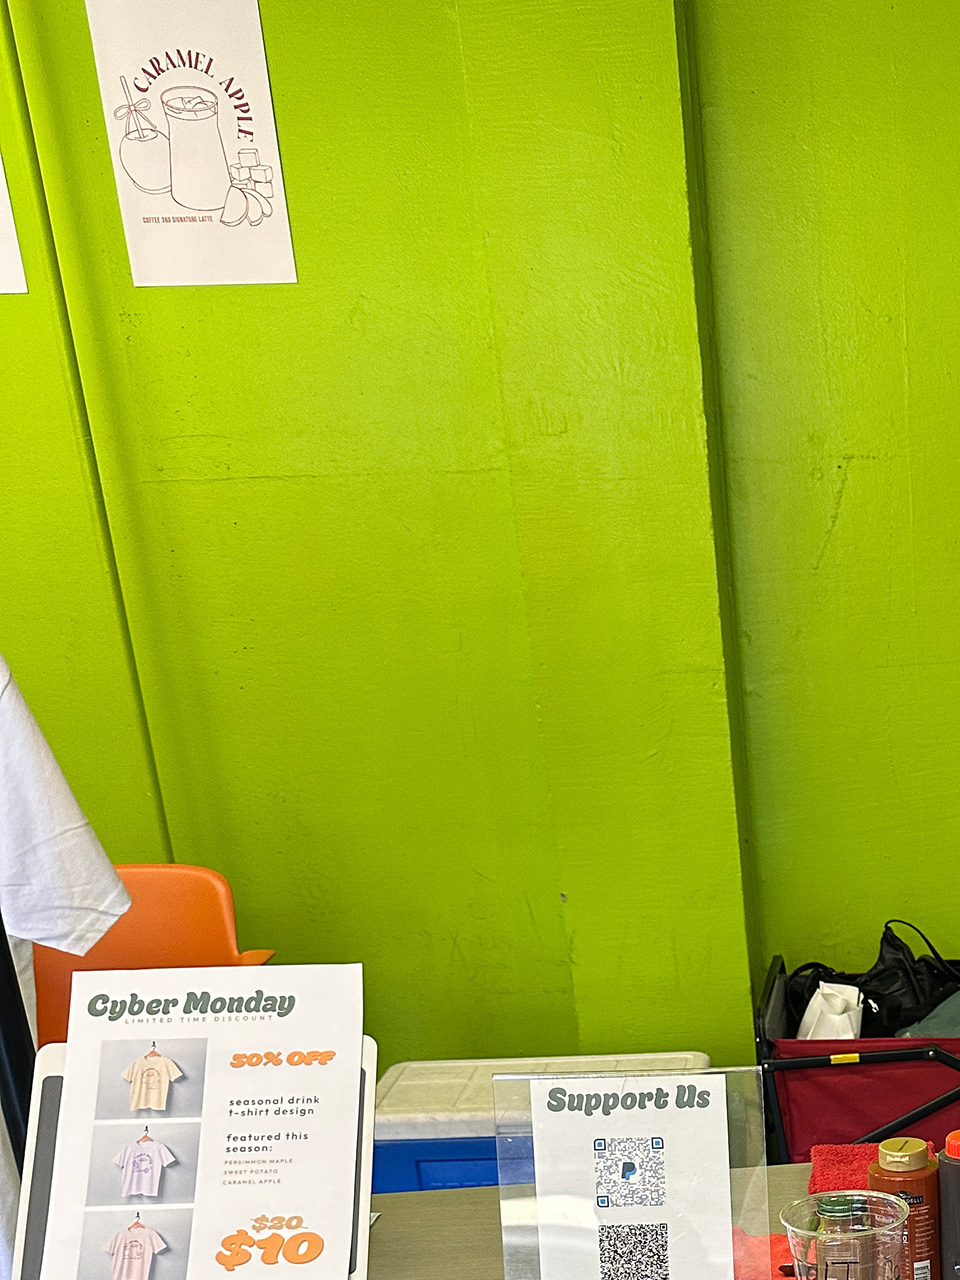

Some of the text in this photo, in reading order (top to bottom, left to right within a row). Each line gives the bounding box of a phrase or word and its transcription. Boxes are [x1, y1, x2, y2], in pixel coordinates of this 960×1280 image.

[133, 49, 254, 142] CARAMEL APPLE
[172, 215, 198, 223] SIGNATURE
[87, 990, 296, 1021] Cyber Monday
[124, 1016, 173, 1024] LIMITED
[230, 1050, 336, 1068] 50% OFF
[229, 1095, 320, 1106] seasonal drink
[547, 1084, 711, 1117] Support Us
[228, 1107, 314, 1117] t-shirt design
[226, 1132, 309, 1142] featured this
[225, 1145, 273, 1153] season:
[251, 1214, 305, 1233] $20
[215, 1229, 325, 1271] $10
